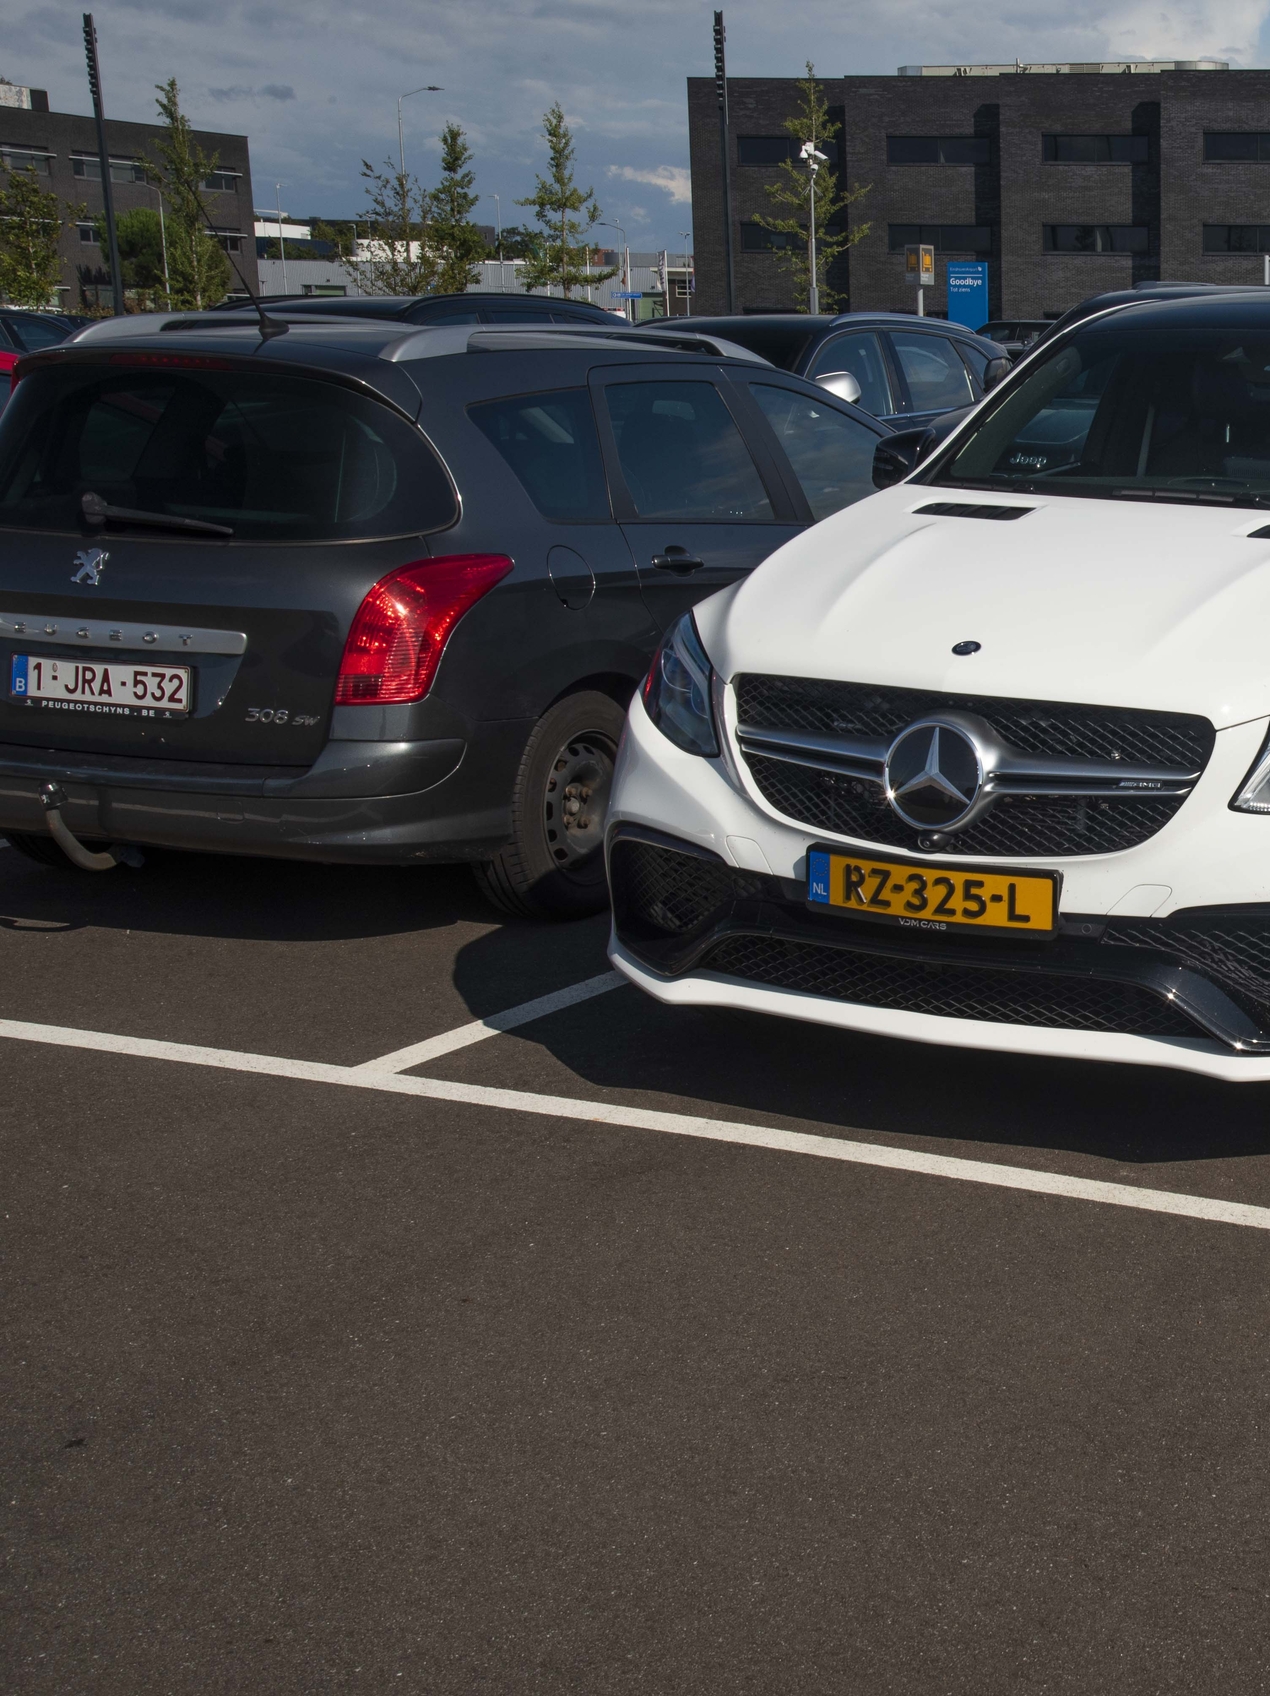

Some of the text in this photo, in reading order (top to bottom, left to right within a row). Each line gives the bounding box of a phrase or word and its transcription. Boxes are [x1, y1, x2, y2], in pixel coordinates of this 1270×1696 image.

[950, 278, 982, 287] Goodbye
[1009, 452, 1047, 468] Jeep
[15, 662, 184, 704] B 1-JRA-532
[245, 708, 289, 725] 308
[812, 863, 1030, 923] NL RZ-325-L
[920, 920, 947, 931] CARS
